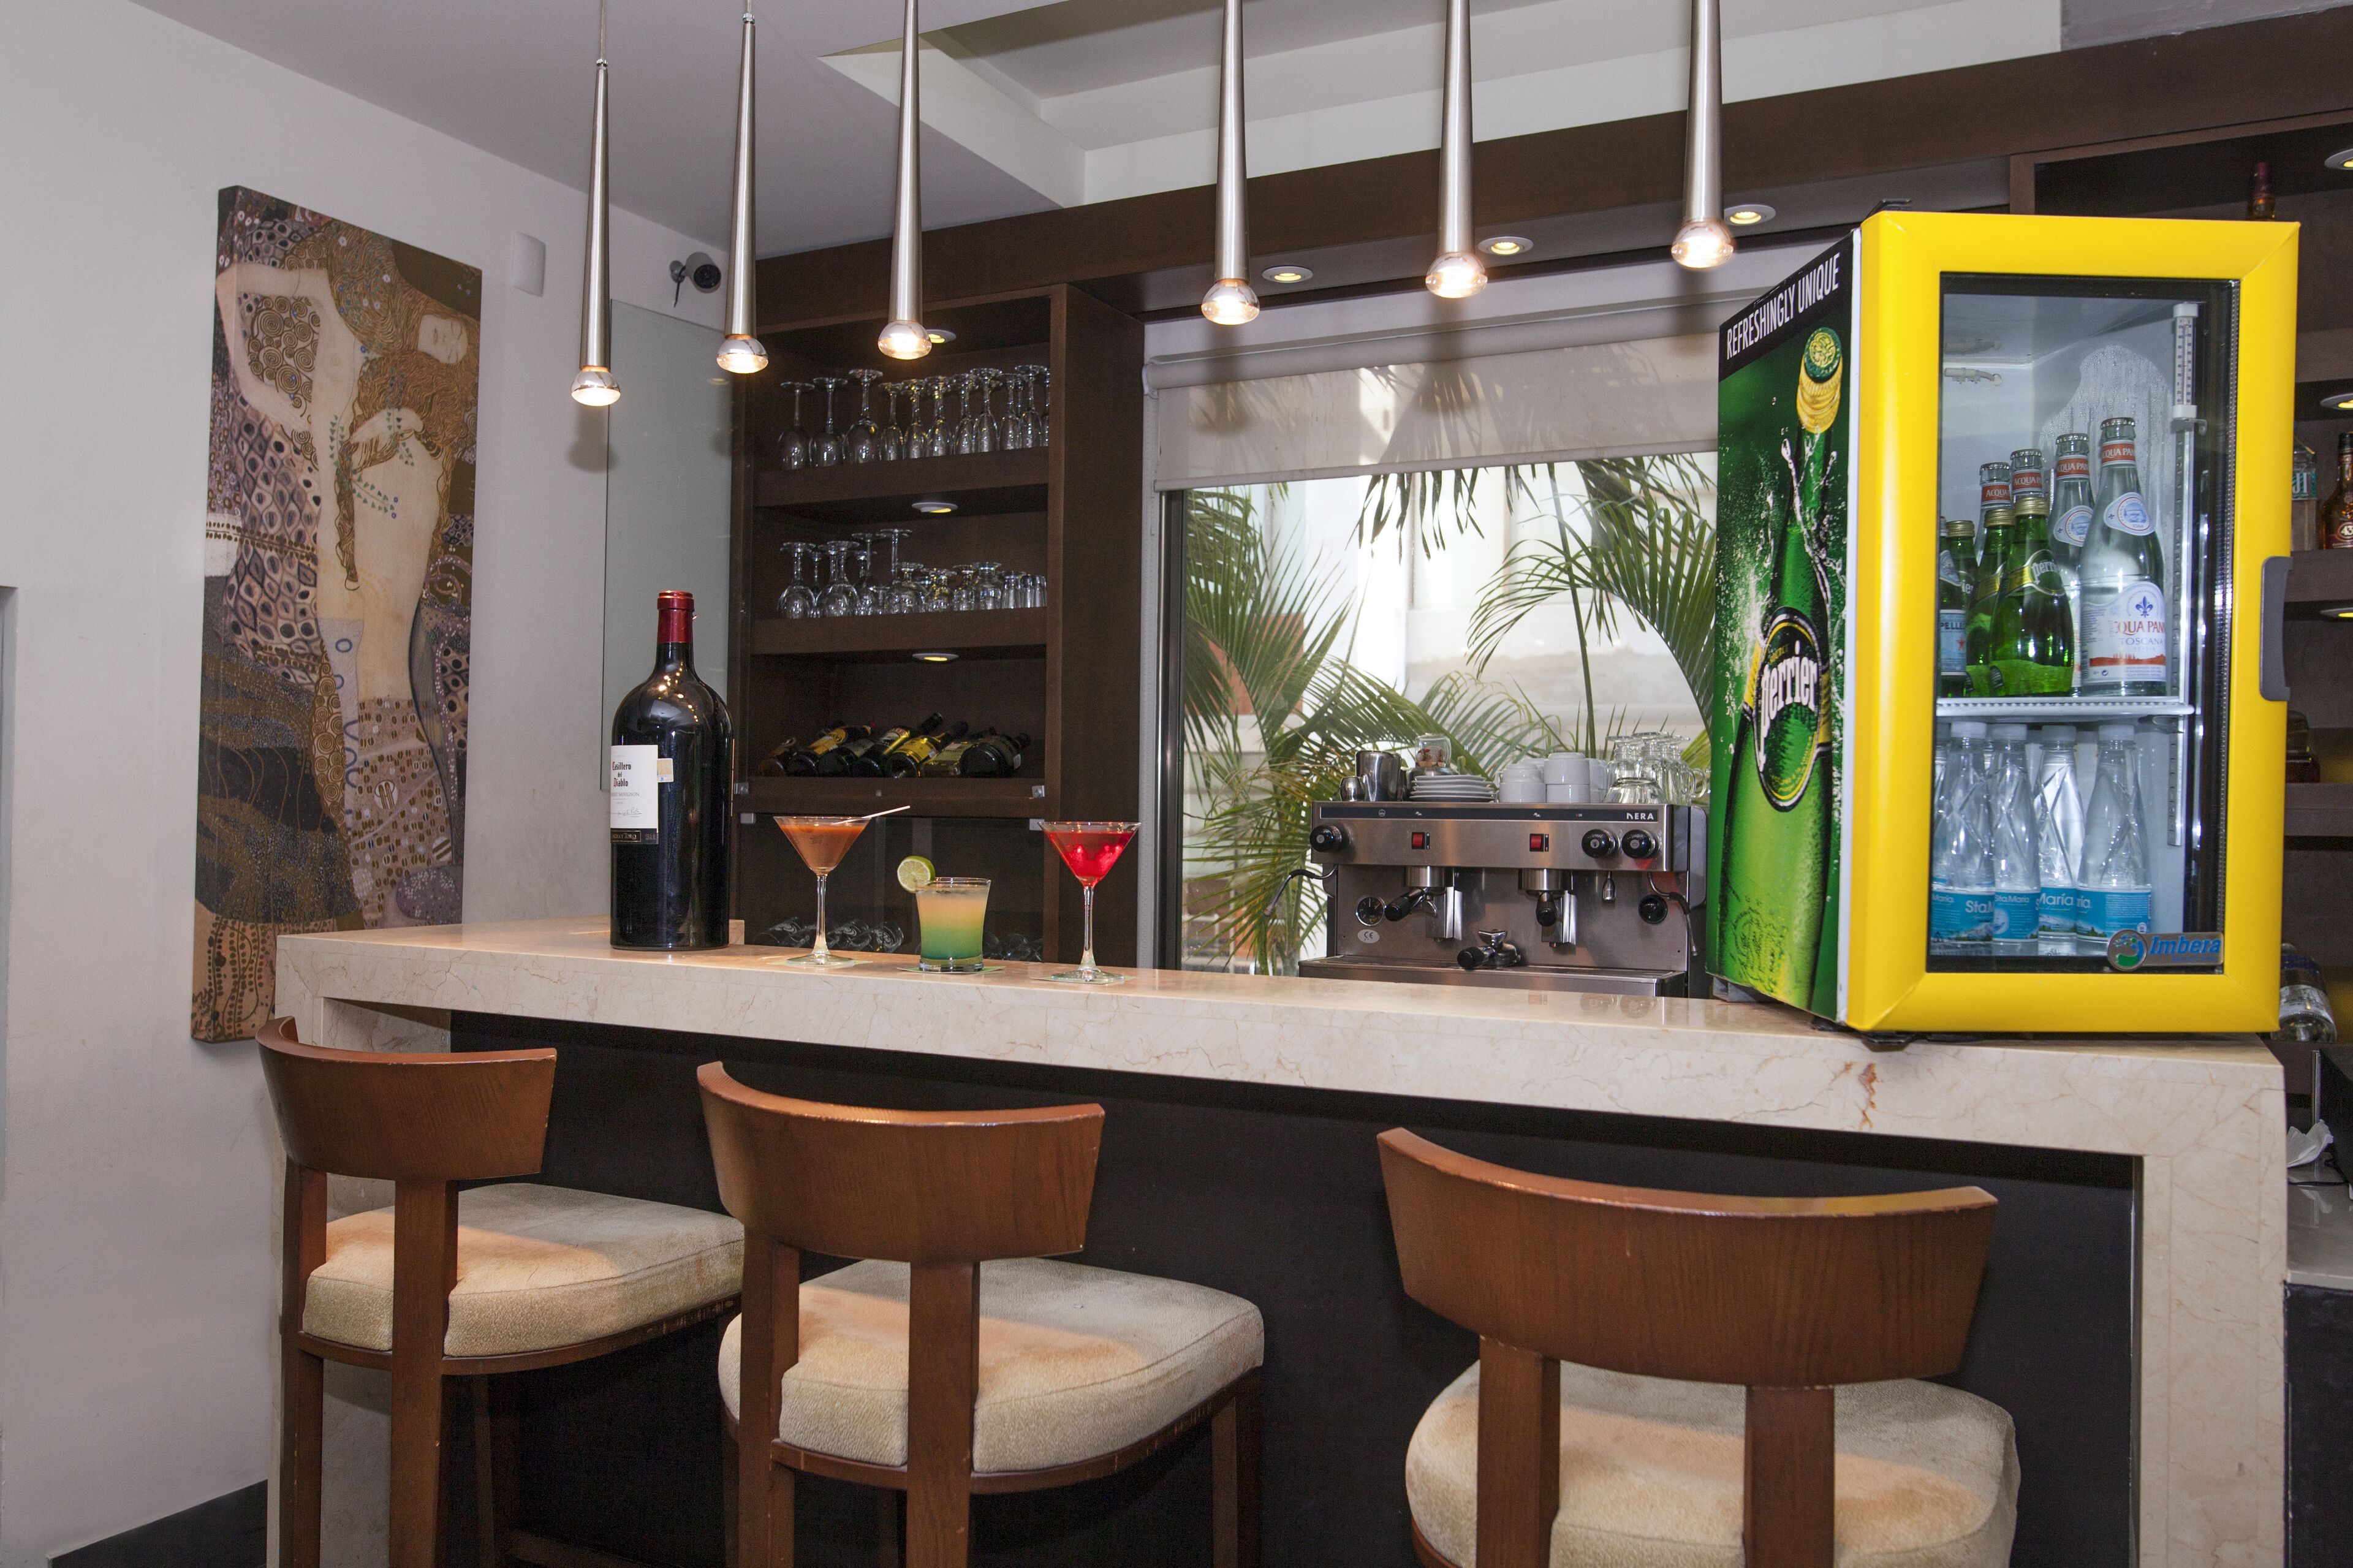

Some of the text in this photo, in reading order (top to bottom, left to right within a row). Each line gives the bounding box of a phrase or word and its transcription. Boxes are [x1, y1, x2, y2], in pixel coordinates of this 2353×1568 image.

[1727, 252, 1840, 360] REFRESHINGLY UNIQUE
[1986, 489, 2008, 498] ACQUA
[2340, 525, 2353, 536] 43
[612, 761, 632, 771] Casillero
[613, 778, 628, 787] Diablo
[2149, 935, 2222, 955] Imbera
